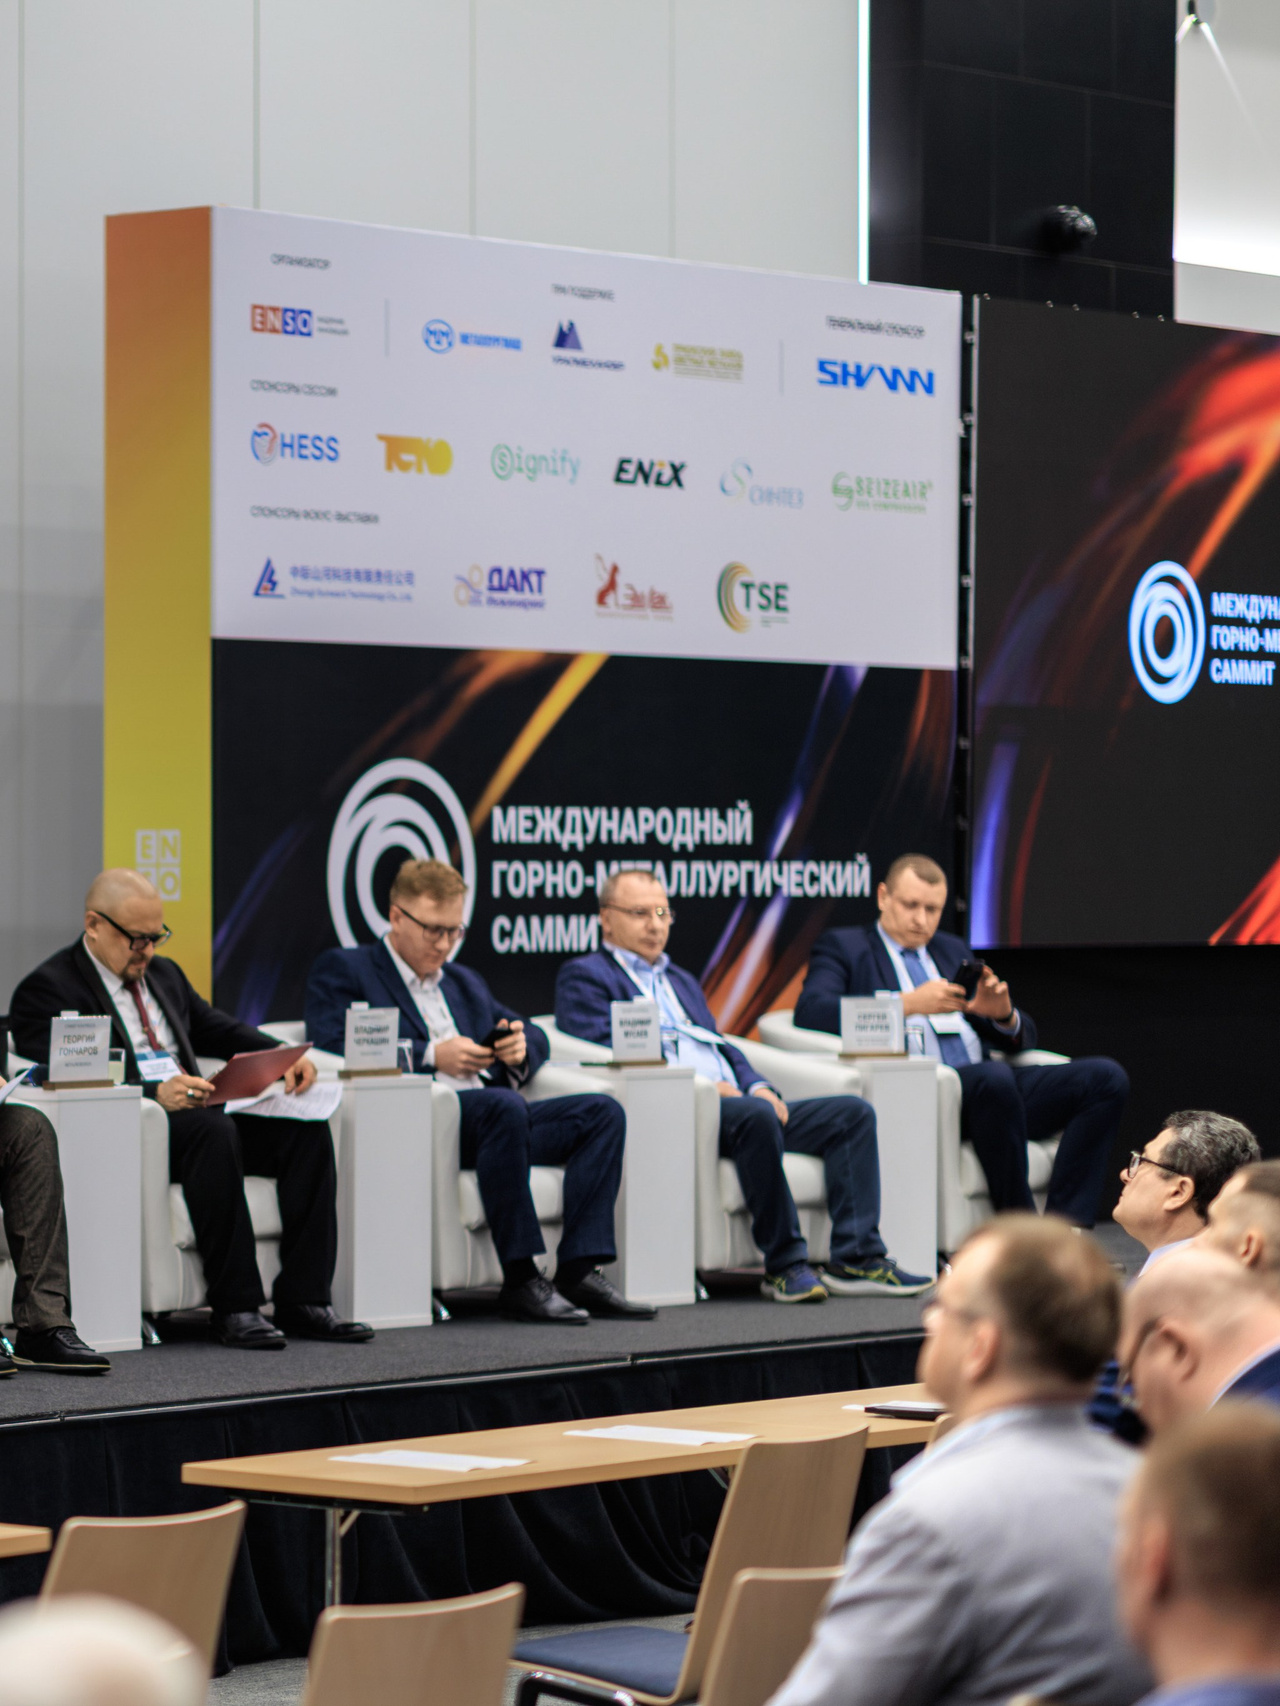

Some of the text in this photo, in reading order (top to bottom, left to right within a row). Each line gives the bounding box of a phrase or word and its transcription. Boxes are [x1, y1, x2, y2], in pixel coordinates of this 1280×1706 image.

[252, 306, 312, 336] ENSO
[280, 432, 340, 463] HESS
[491, 443, 581, 485] Signify
[740, 580, 790, 613] TSE
[1211, 591, 1280, 624] МЕЖДУН
[1210, 657, 1277, 686] САММИТ
[491, 800, 753, 852] МЕЖДУНАРОДНЫЙ
[491, 853, 871, 898] ГОРНО-МАЛЛУРГИЧЕСКИЙ
[491, 914, 602, 954] САММИ
[59, 1046, 99, 1057] ГОНЧАРОВ
[63, 1031, 96, 1044] ГЕОРГИЙ
